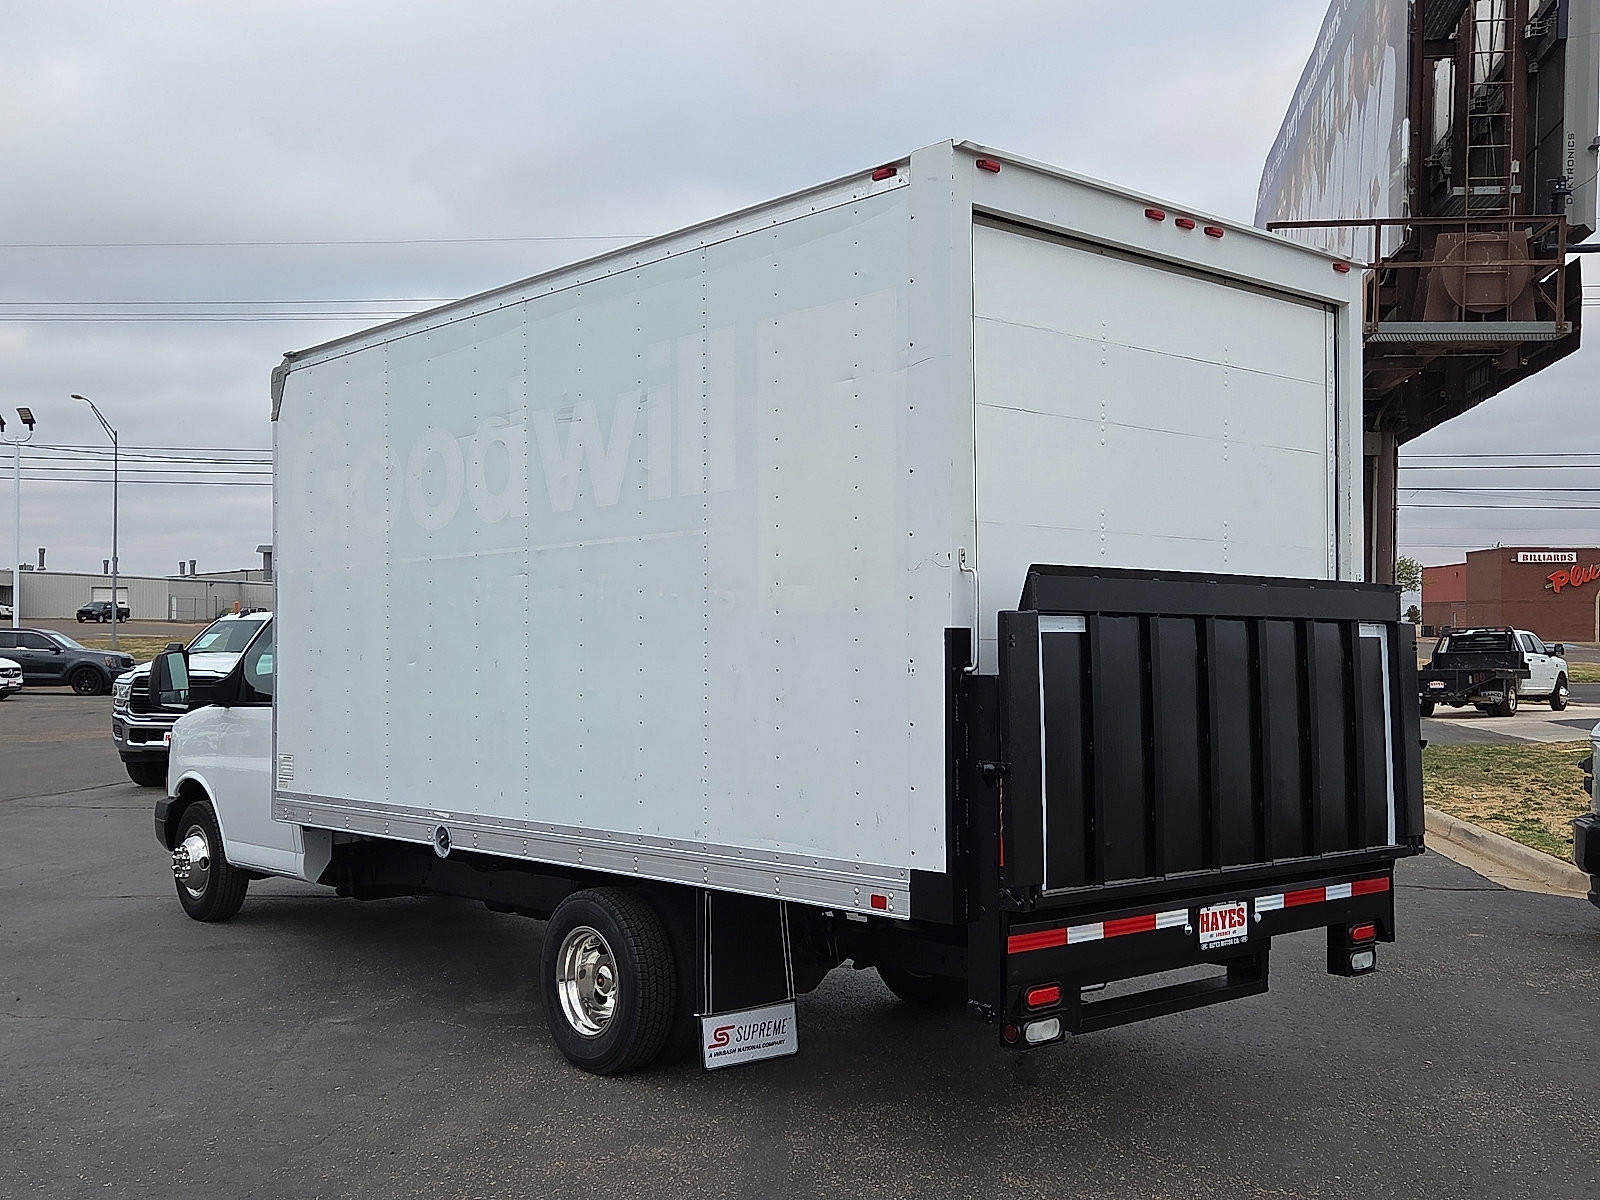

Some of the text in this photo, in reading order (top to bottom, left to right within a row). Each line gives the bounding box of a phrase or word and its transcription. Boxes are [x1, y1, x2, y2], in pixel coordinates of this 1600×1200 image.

[294, 325, 736, 545] Goodwill
[1522, 553, 1574, 562] BILLIARDS
[1546, 564, 1600, 594] Plu
[1200, 907, 1246, 933] HAYES
[736, 1018, 788, 1043] SUPREME
[708, 1039, 786, 1059] A WABASH NATIONAL COMPANY
